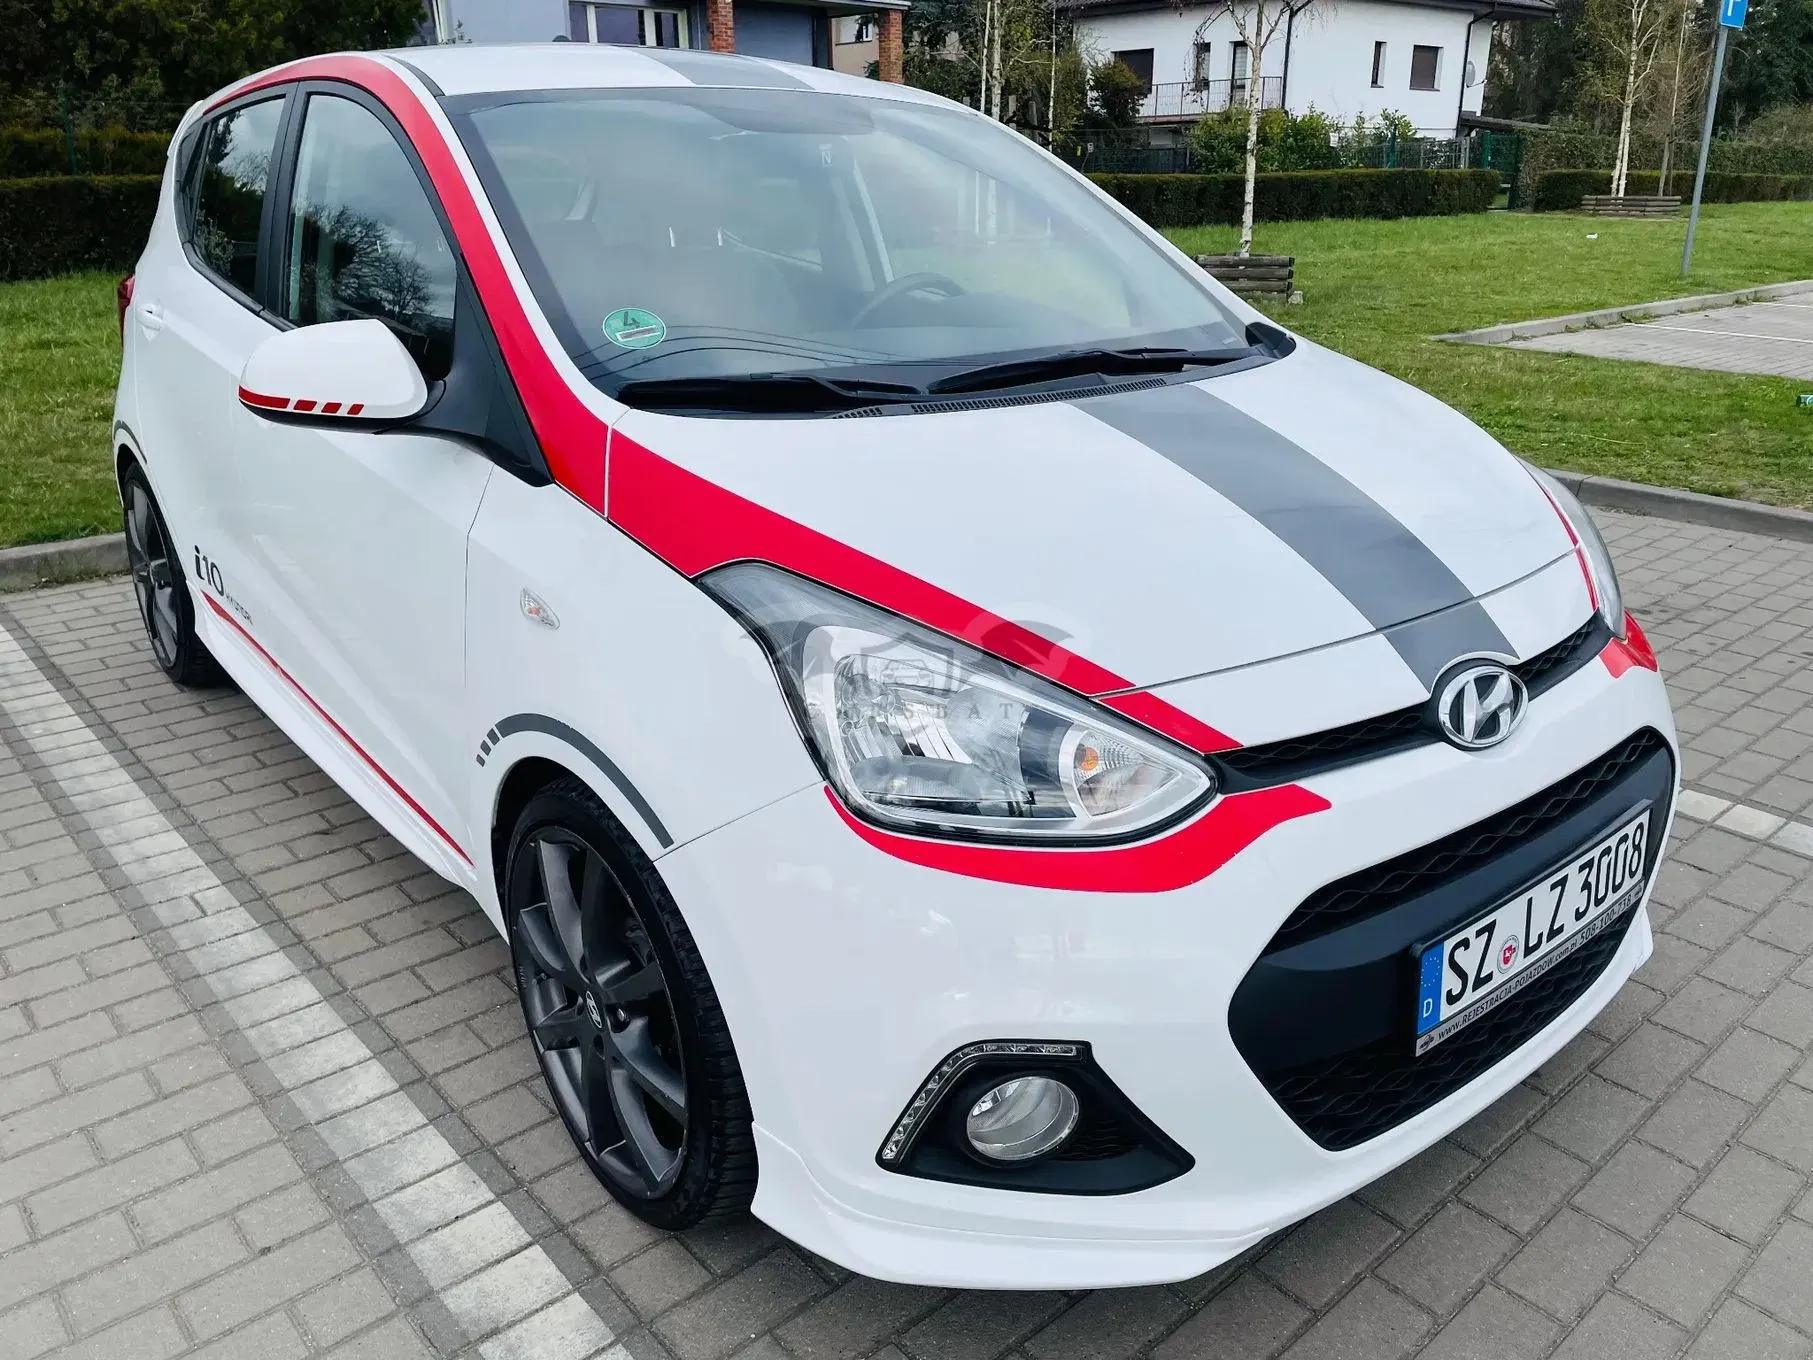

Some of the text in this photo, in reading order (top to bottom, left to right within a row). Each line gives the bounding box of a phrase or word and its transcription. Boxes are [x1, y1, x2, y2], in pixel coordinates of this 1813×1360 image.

[623, 311, 641, 328] 4
[194, 544, 225, 597] i10
[1445, 918, 1497, 1006] SZ
[1523, 873, 1569, 959] LZ
[1574, 821, 1645, 922] 3008
[1423, 997, 1433, 1018] D
